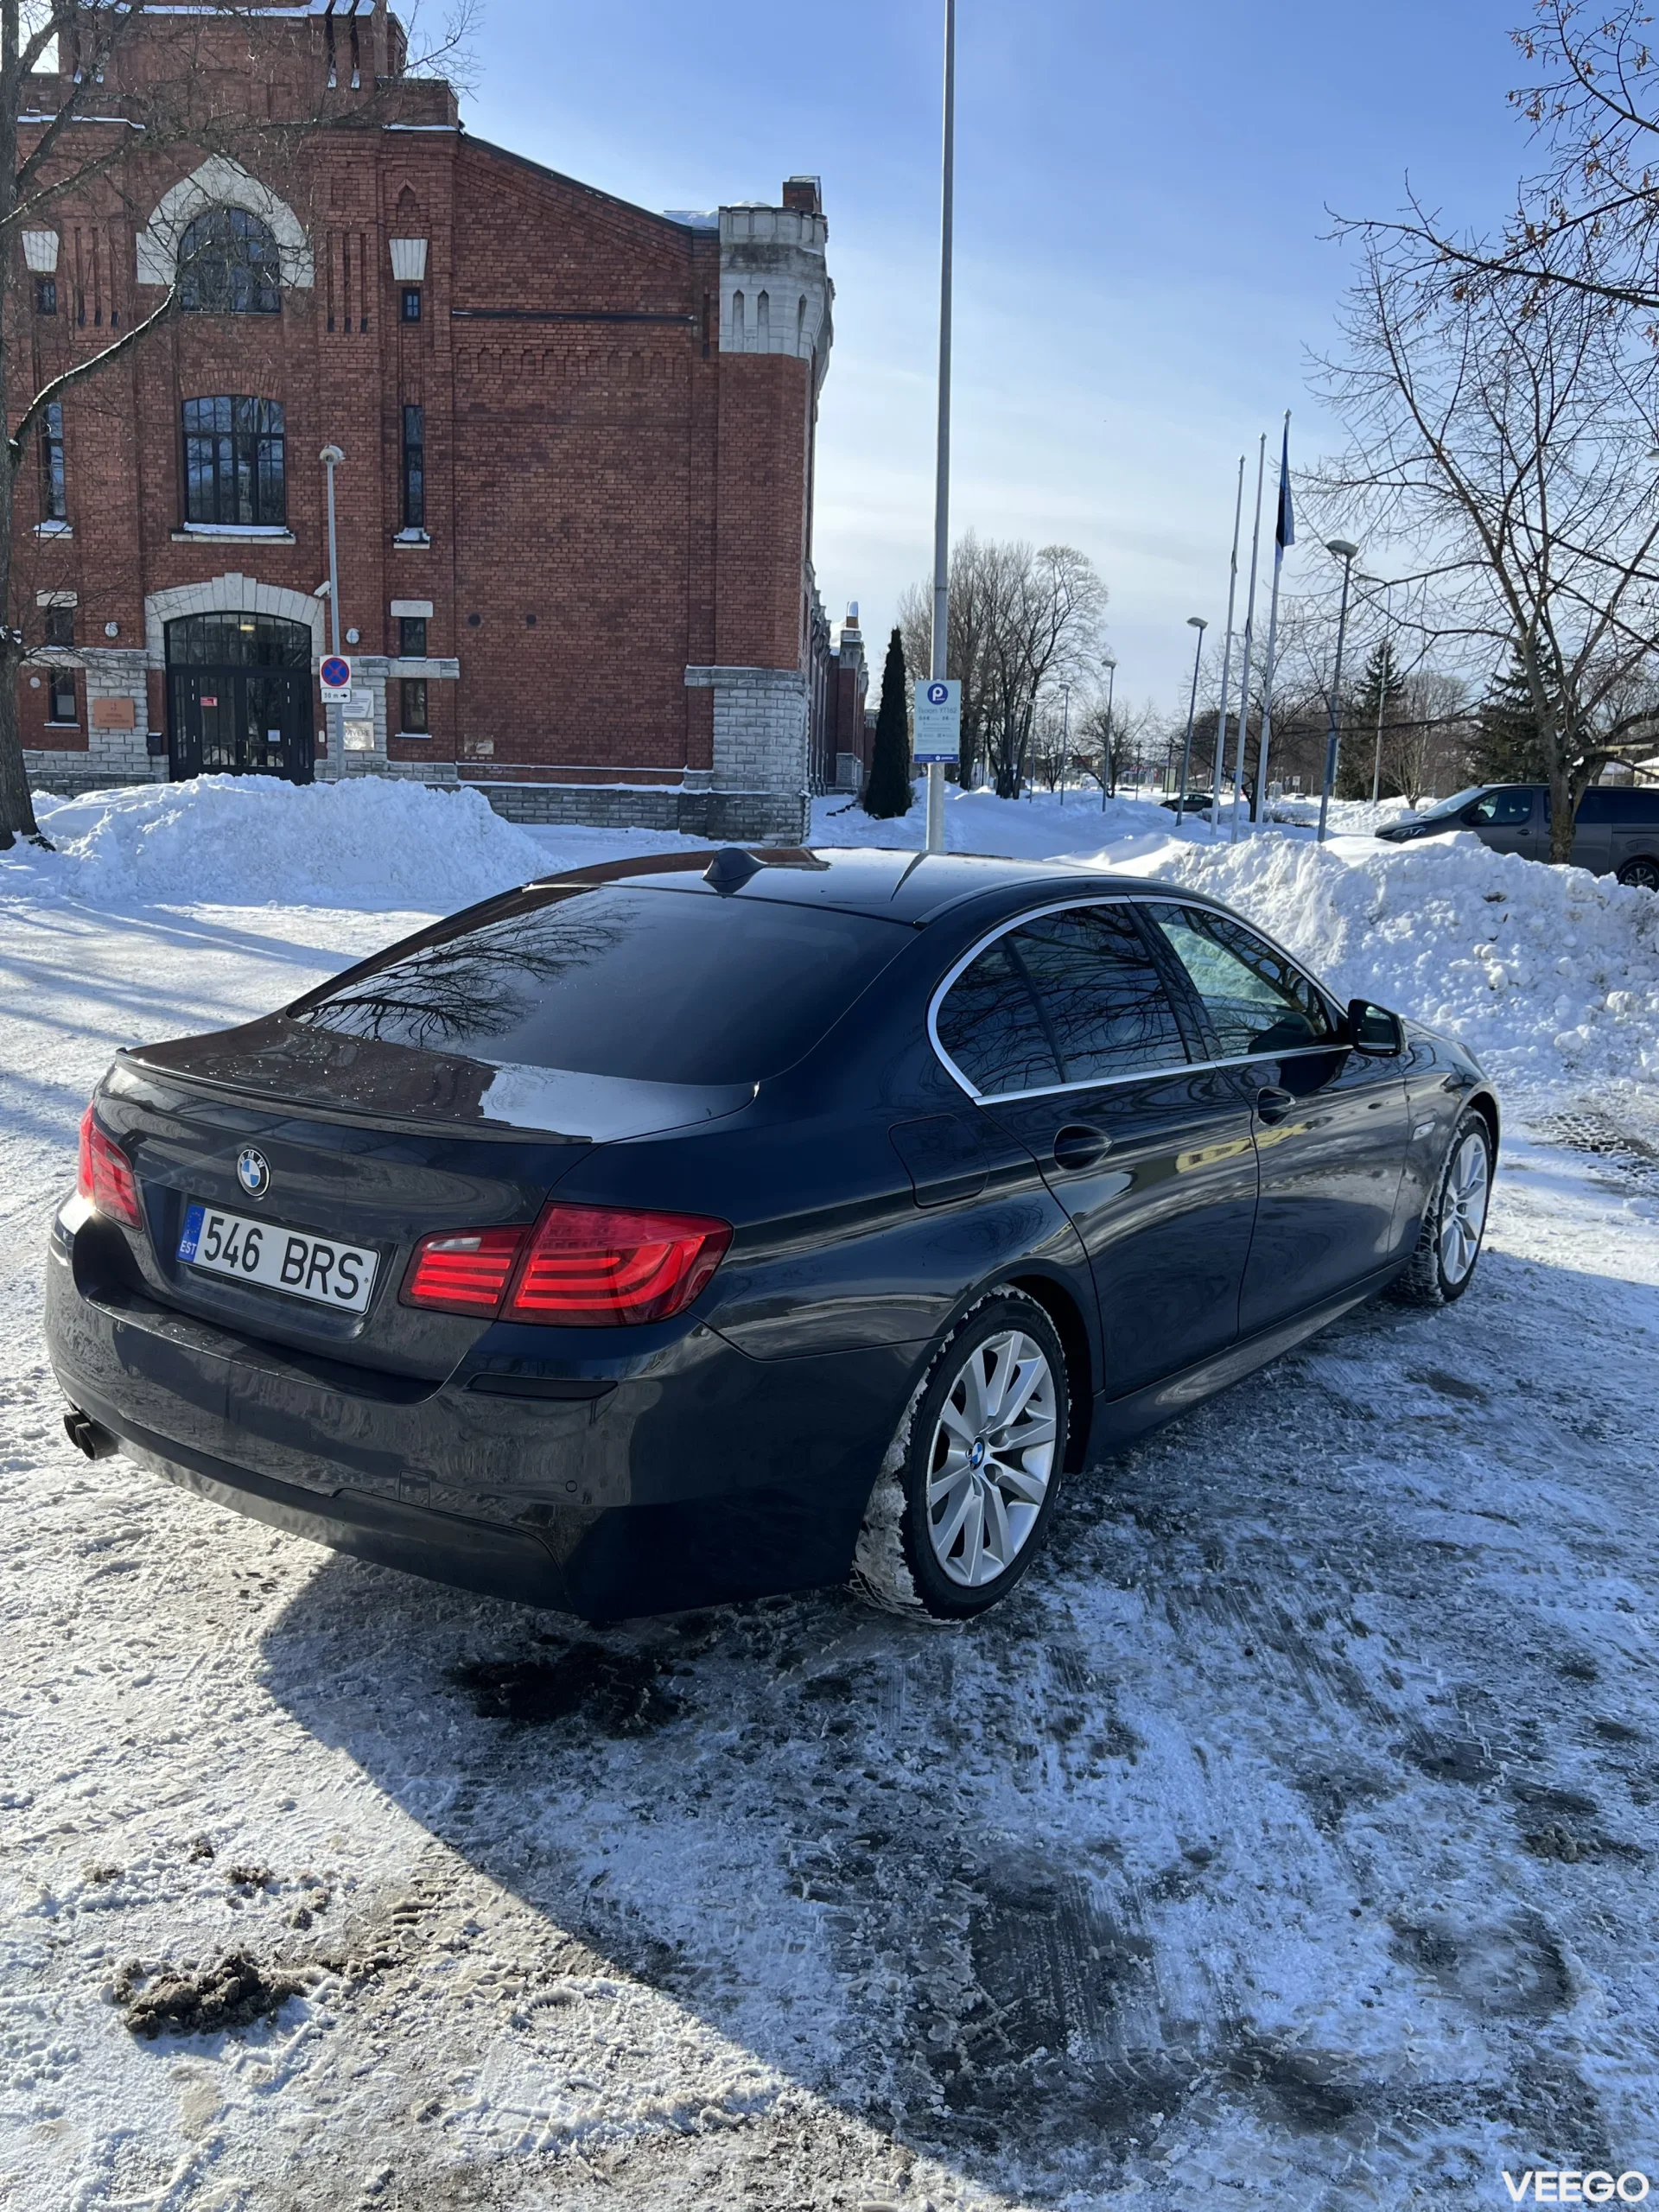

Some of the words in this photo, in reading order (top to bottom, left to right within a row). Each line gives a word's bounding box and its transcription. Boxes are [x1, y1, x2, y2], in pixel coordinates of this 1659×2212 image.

[238, 1150, 265, 1168] BMW
[179, 1239, 197, 1255] EST
[204, 1215, 264, 1273] 546
[280, 1236, 364, 1300] BRS
